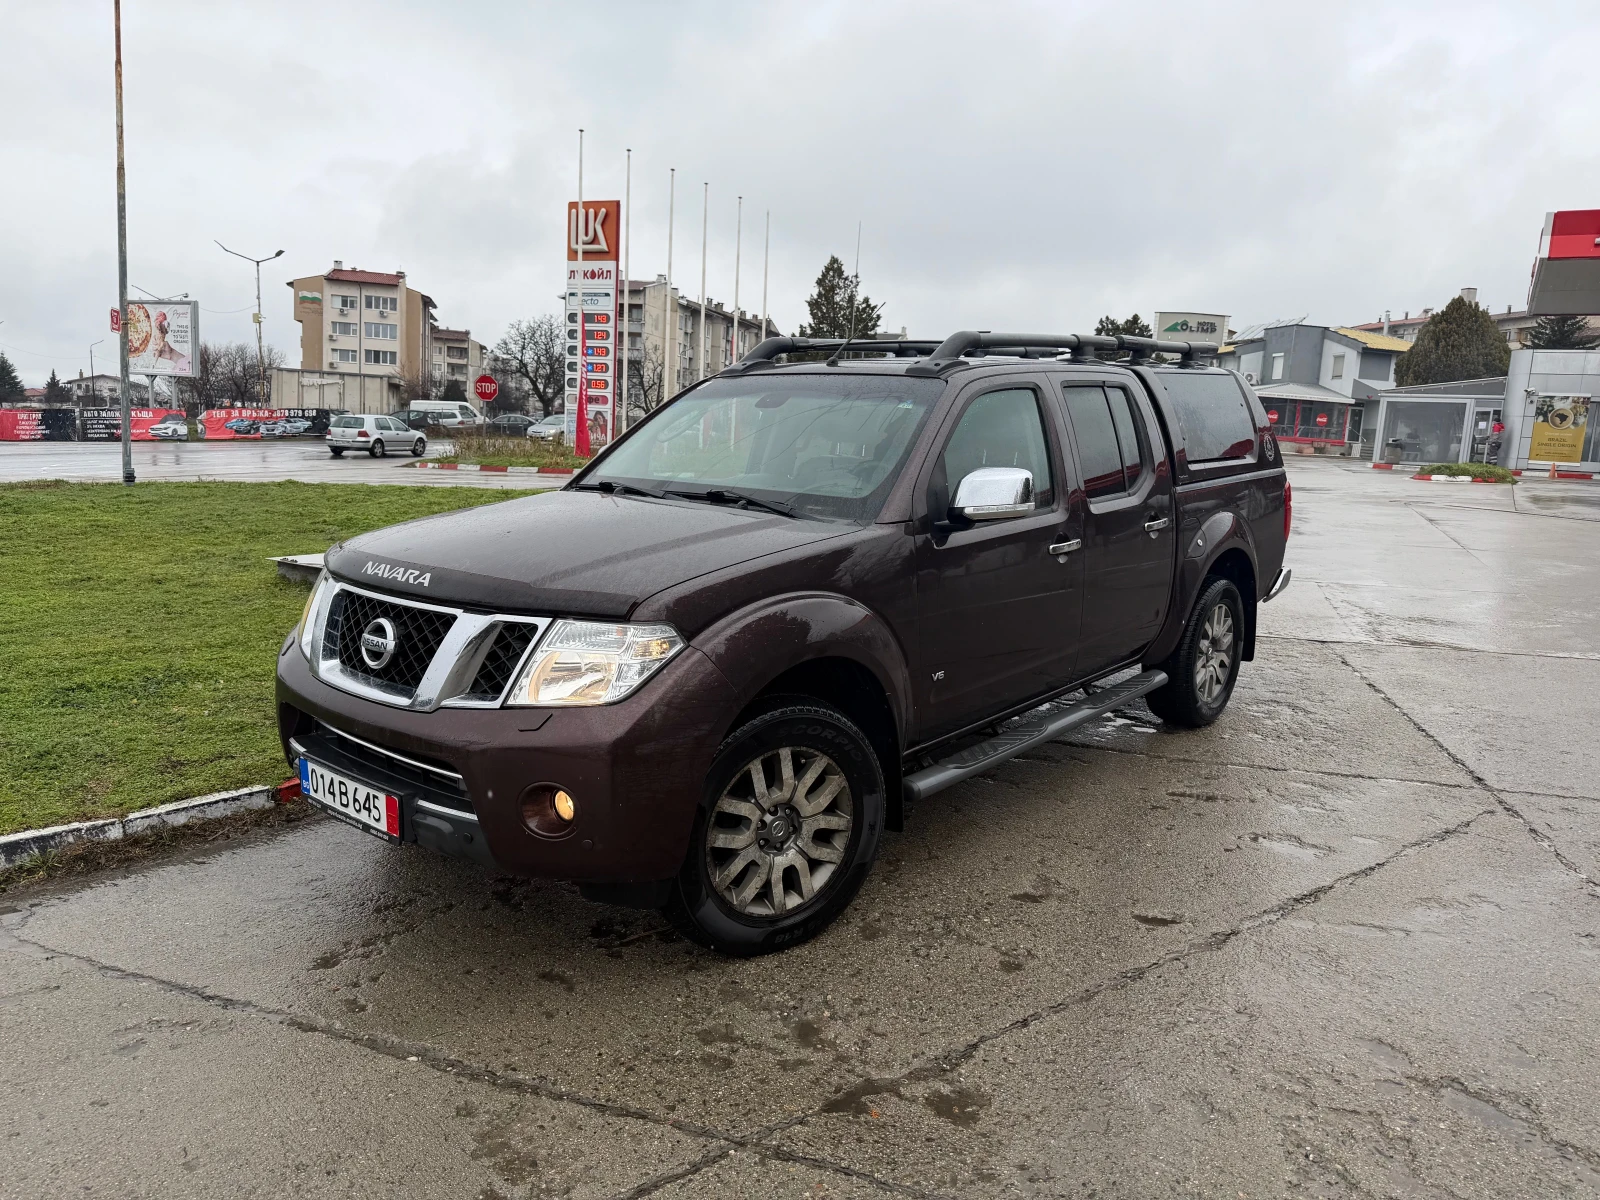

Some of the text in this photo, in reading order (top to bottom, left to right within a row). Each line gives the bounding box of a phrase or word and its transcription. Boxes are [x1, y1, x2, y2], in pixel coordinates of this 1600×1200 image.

[1180, 322, 1217, 334] OLIMP
[476, 383, 496, 393] STOP
[362, 561, 431, 586] NAVARA
[932, 670, 944, 681] V6
